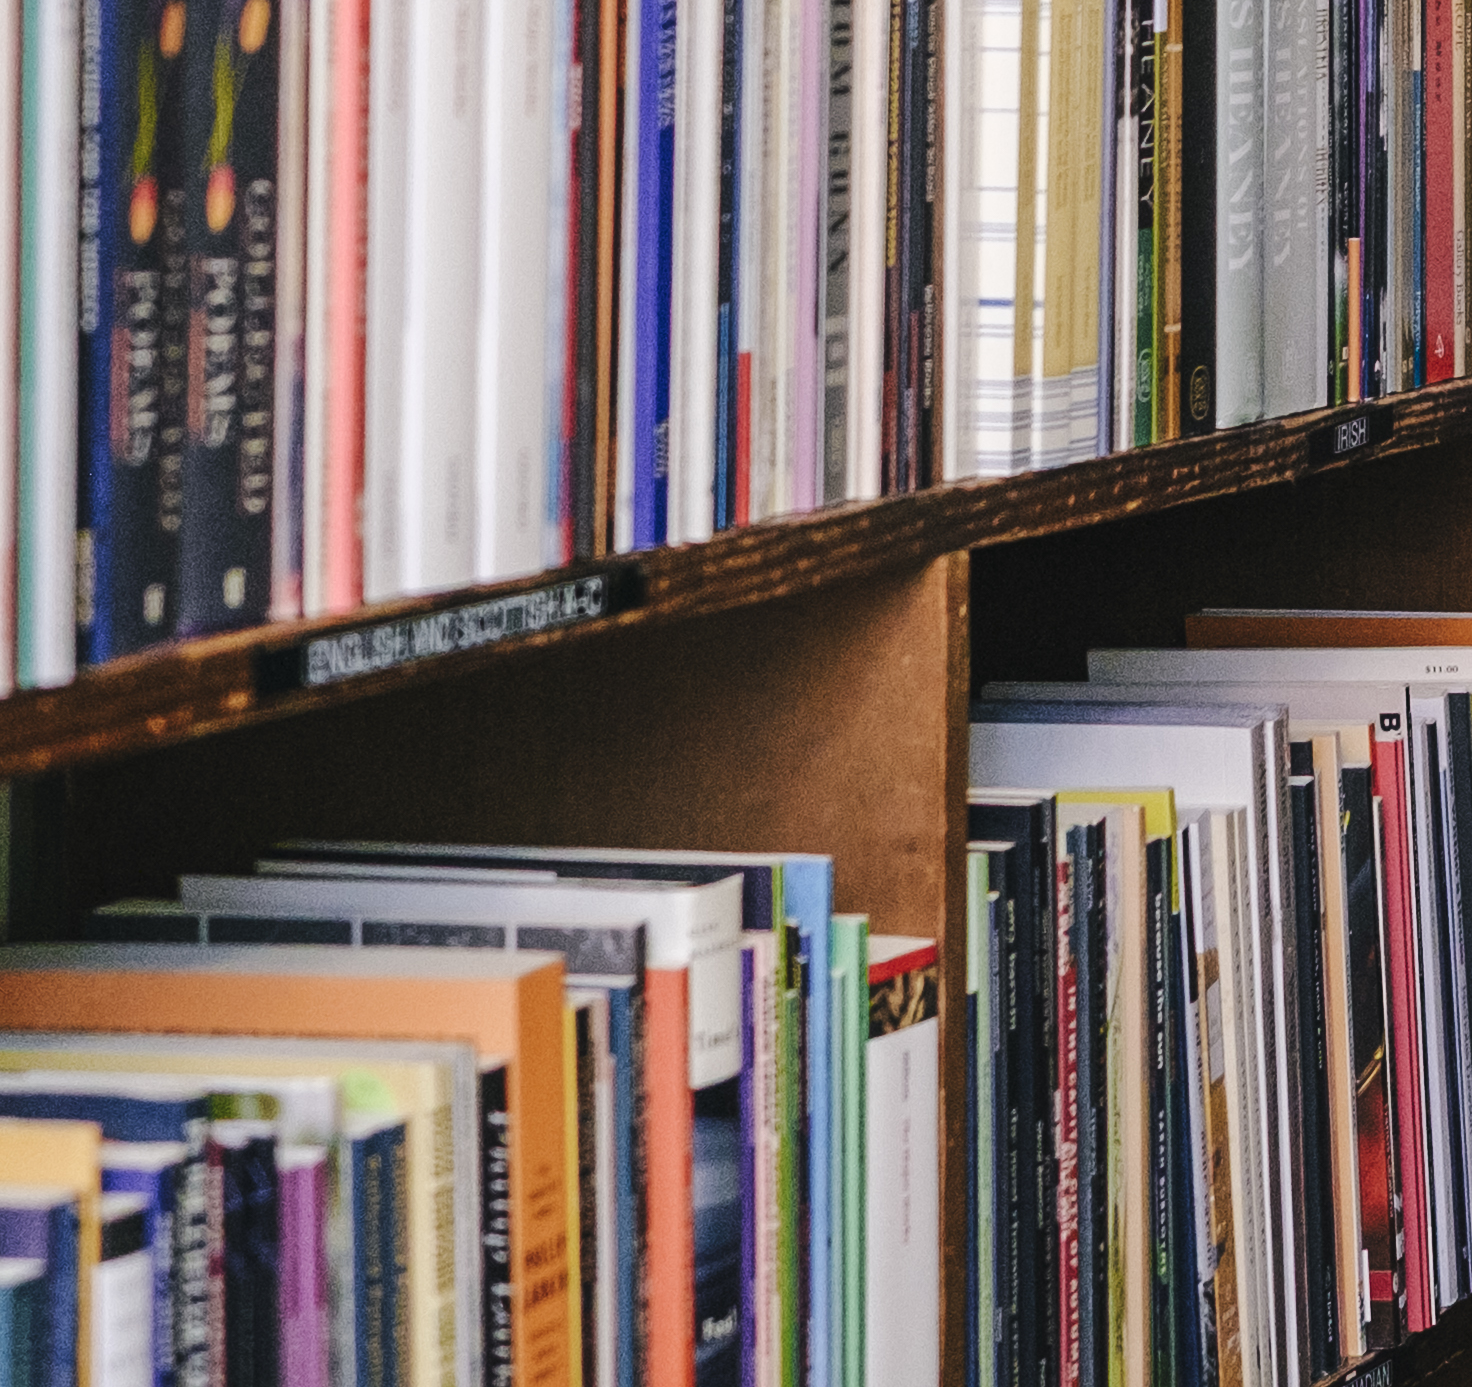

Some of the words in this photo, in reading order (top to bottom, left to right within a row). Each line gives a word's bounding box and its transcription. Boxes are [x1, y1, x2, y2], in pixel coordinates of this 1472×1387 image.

[1140, 18, 1155, 210] HEANEY
[1228, 49, 1254, 274] HEANEY
[1454, 228, 1464, 277] Gallery
[1455, 282, 1464, 326] Books
[1335, 417, 1367, 453] IRISH
[1155, 891, 1163, 983] because
[1067, 1018, 1077, 1063] THE
[1155, 988, 1164, 1023] the
[1068, 1070, 1077, 1170] CAPITAL
[1069, 1279, 1079, 1380] AUTUMN
